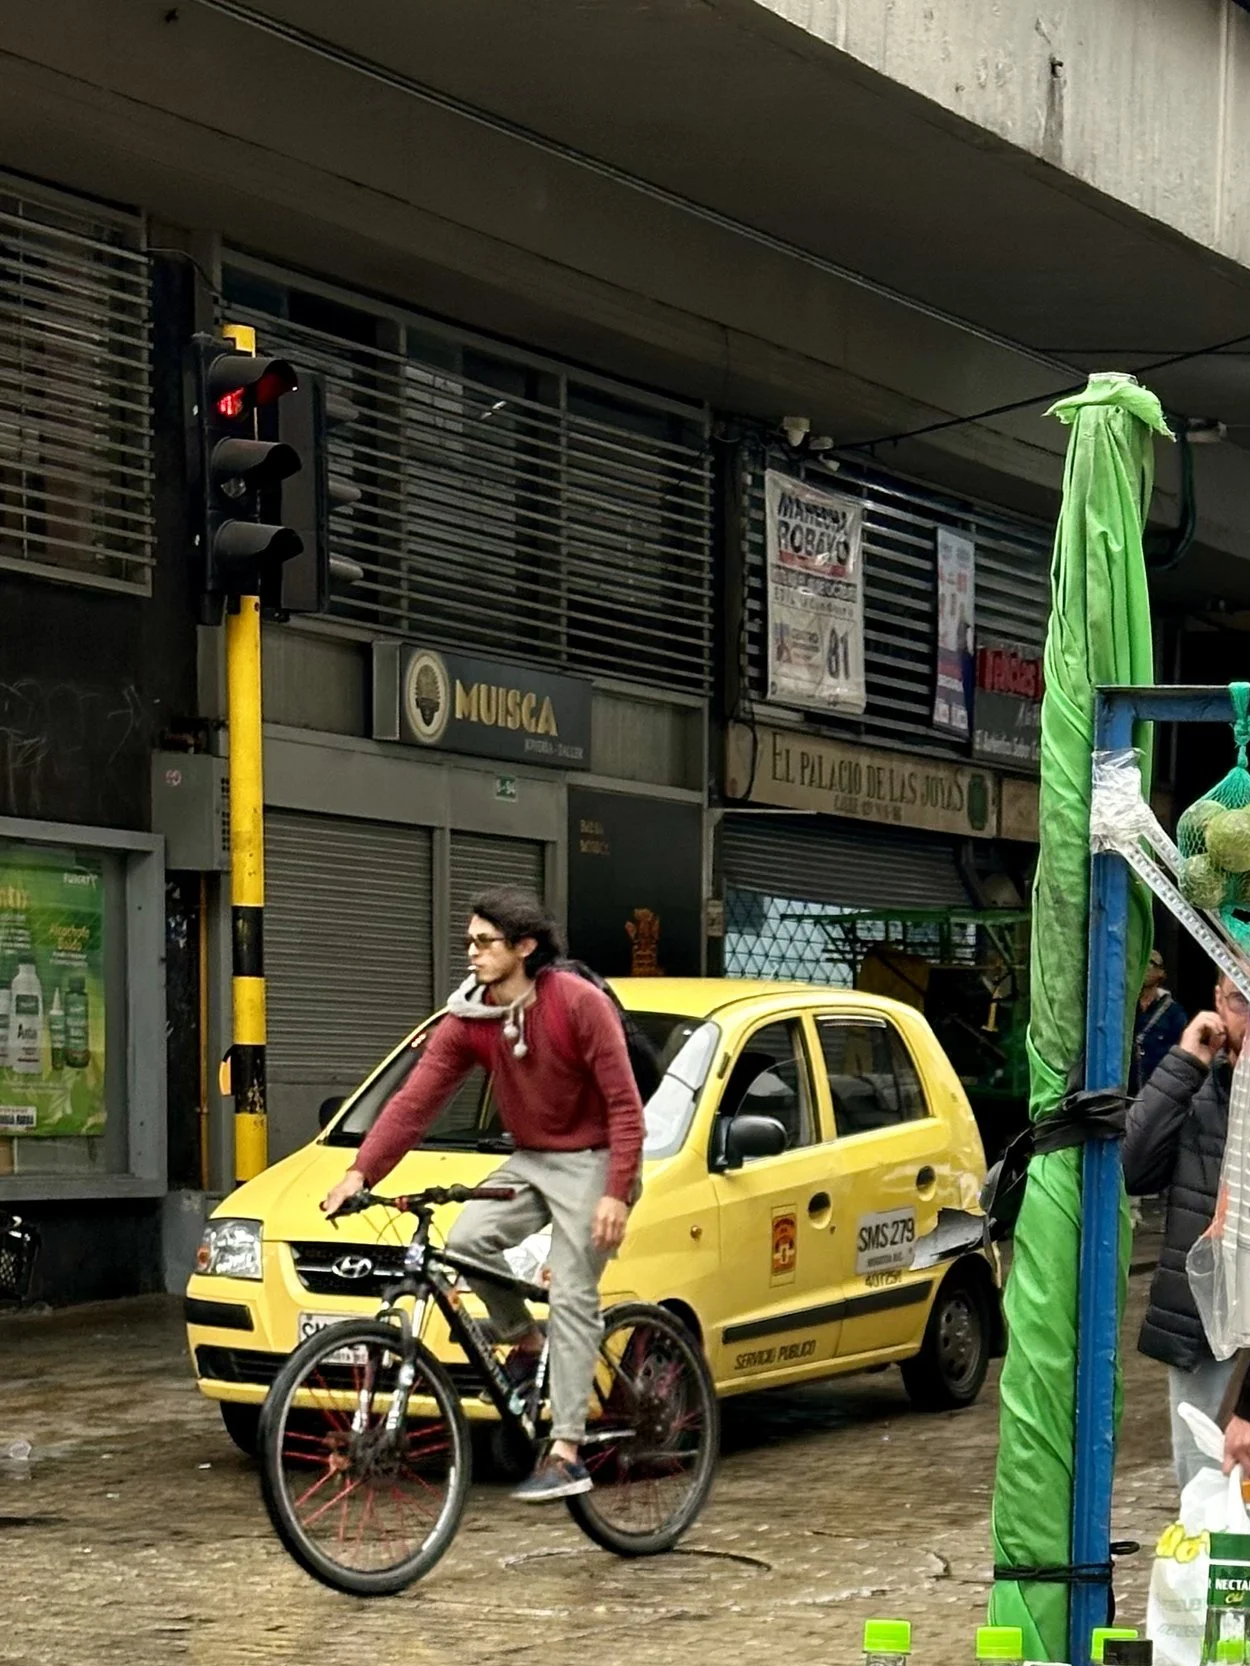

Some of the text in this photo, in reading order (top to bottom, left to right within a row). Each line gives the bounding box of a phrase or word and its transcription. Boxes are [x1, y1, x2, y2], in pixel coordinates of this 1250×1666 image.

[455, 679, 558, 736] MUISCA
[771, 732, 795, 785] EL
[800, 750, 861, 797] PALACIO
[866, 765, 885, 801] DE
[858, 1217, 916, 1253] SMS 279
[734, 1348, 776, 1370] SERVICIO
